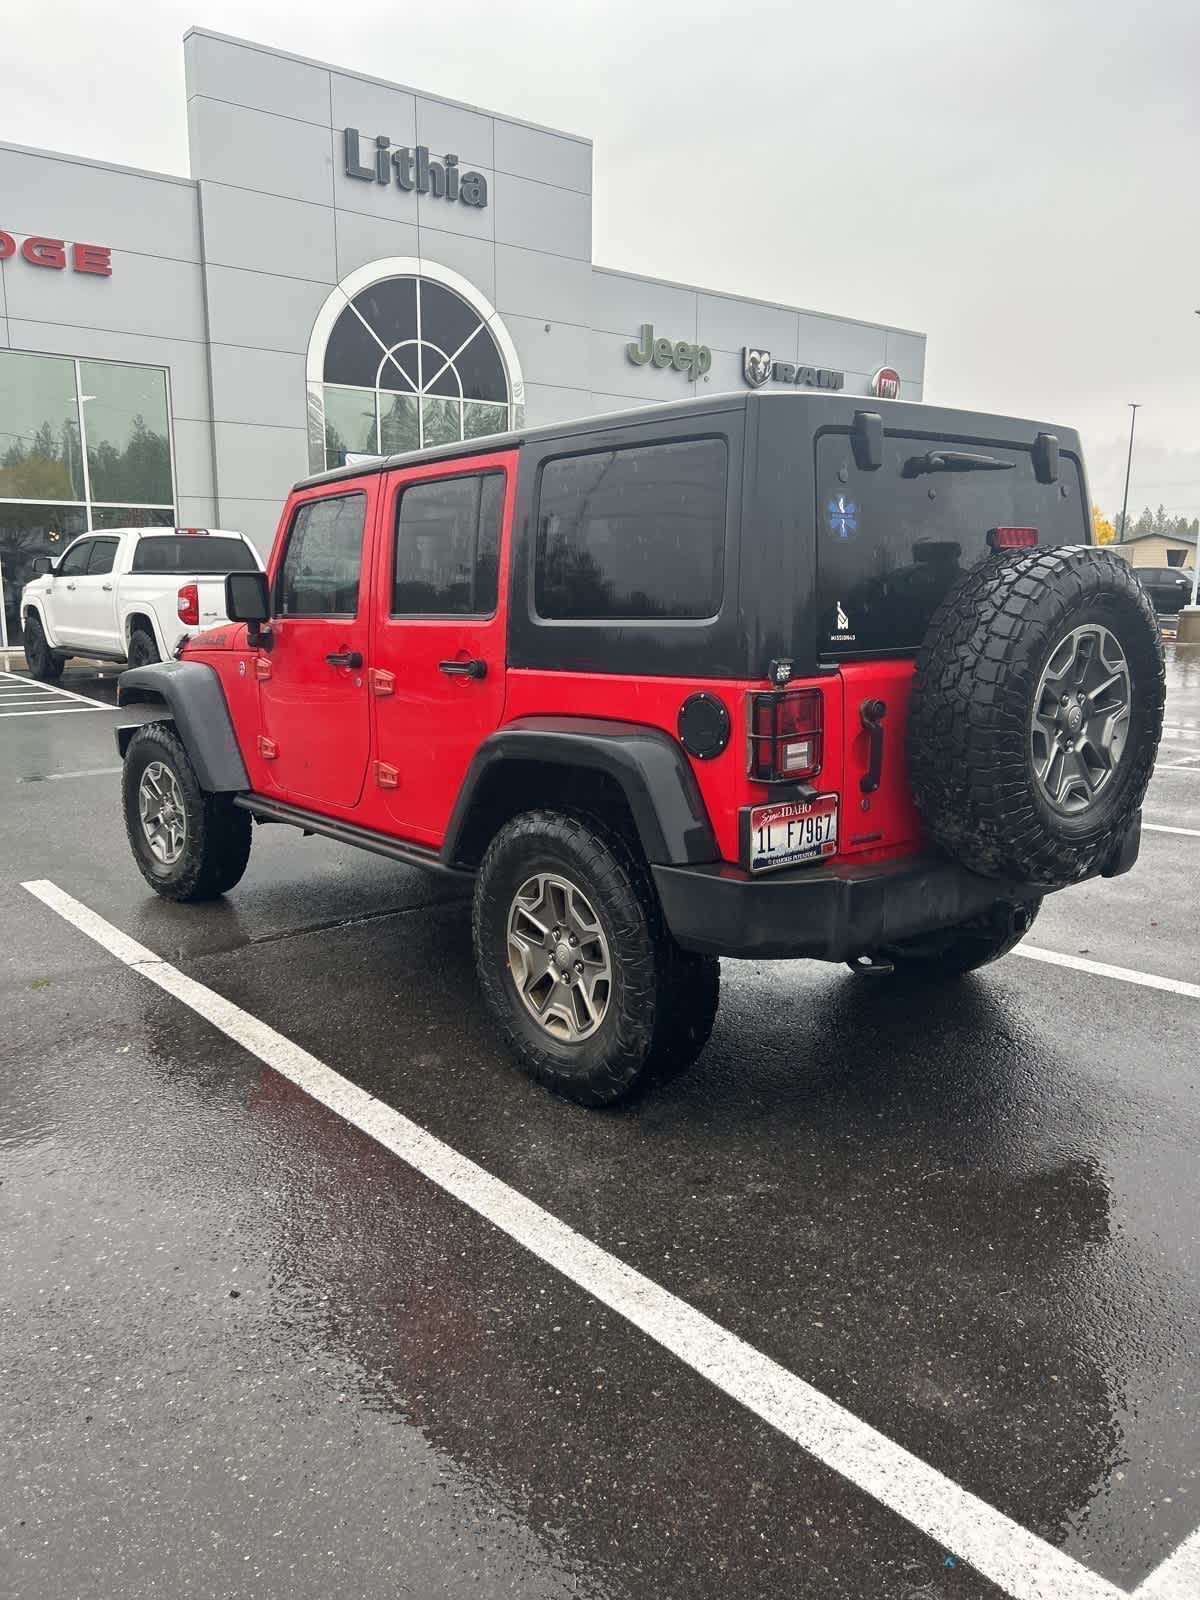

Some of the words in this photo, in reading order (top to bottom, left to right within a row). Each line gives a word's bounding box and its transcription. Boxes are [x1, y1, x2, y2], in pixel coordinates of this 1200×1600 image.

[344, 127, 488, 208] Lithia
[626, 324, 711, 382] Jeep
[772, 362, 844, 390] RAM
[781, 803, 812, 818] IDAHO
[758, 825, 775, 854] 1L
[787, 814, 832, 848] F7967
